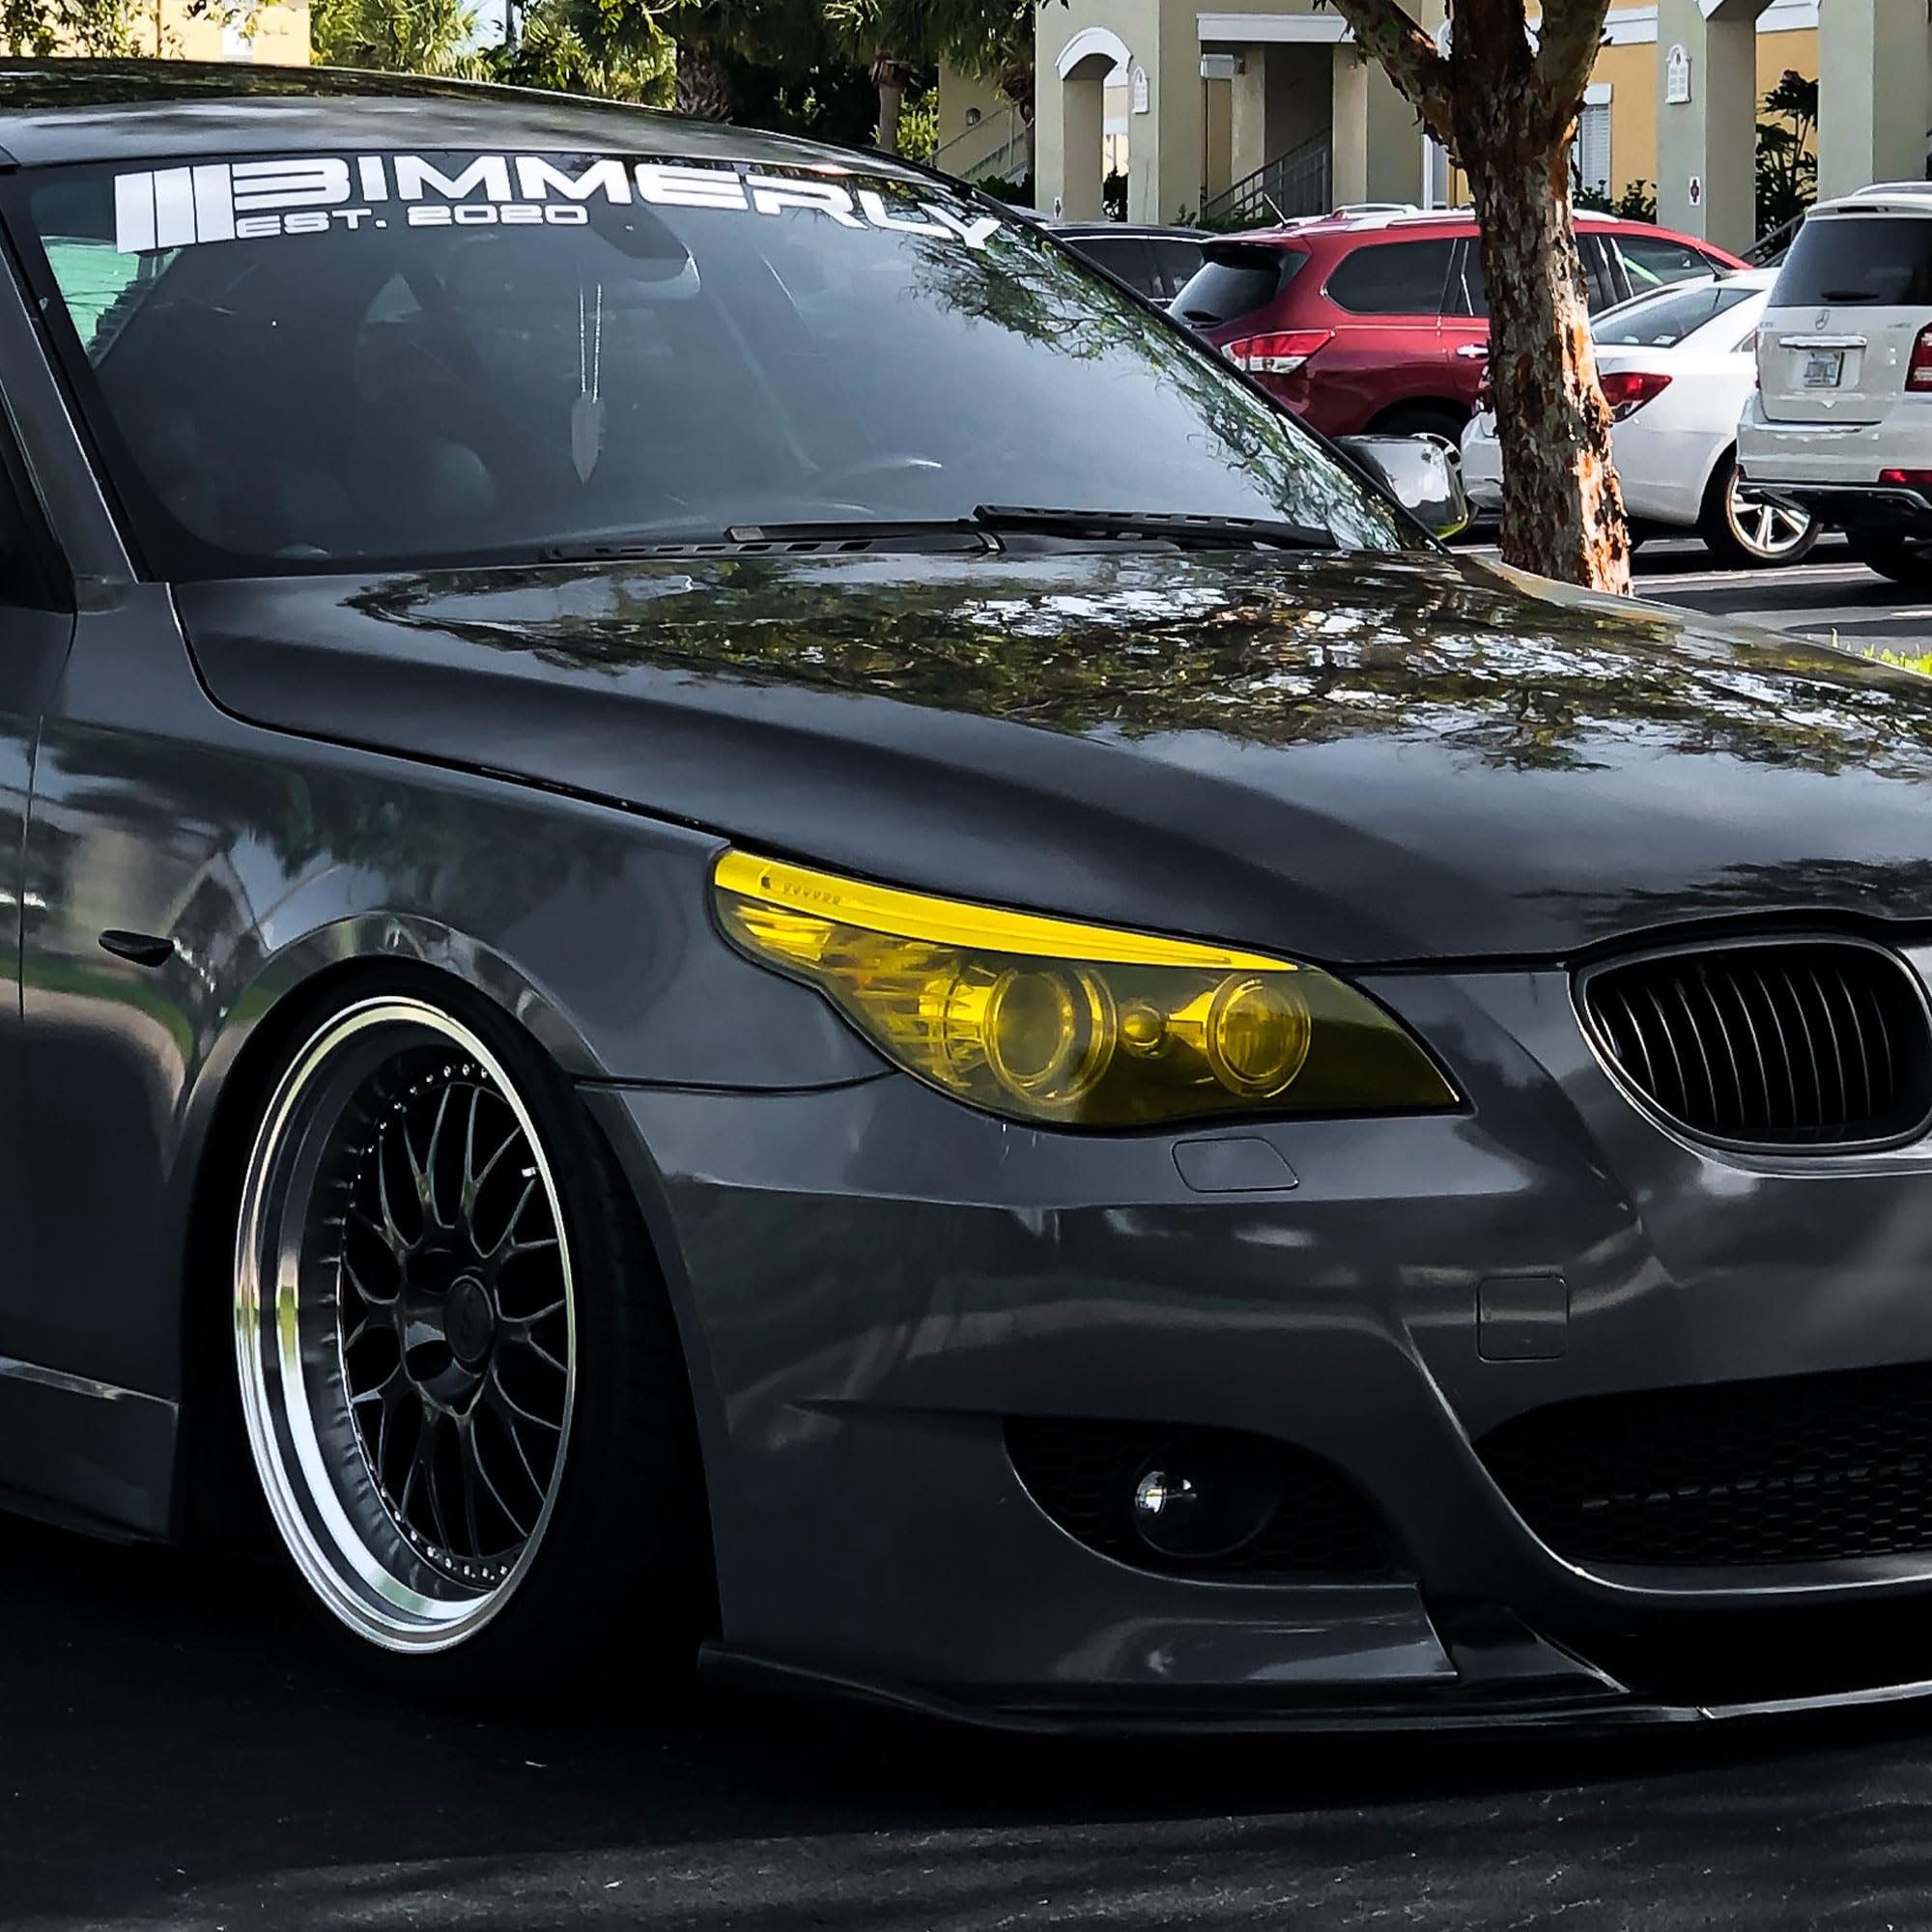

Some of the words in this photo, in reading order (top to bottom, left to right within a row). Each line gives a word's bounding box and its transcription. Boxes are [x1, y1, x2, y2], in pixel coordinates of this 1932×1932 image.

[232, 155, 1002, 250] BIMMERLY
[236, 208, 387, 240] EST.
[407, 204, 590, 227] 2020
